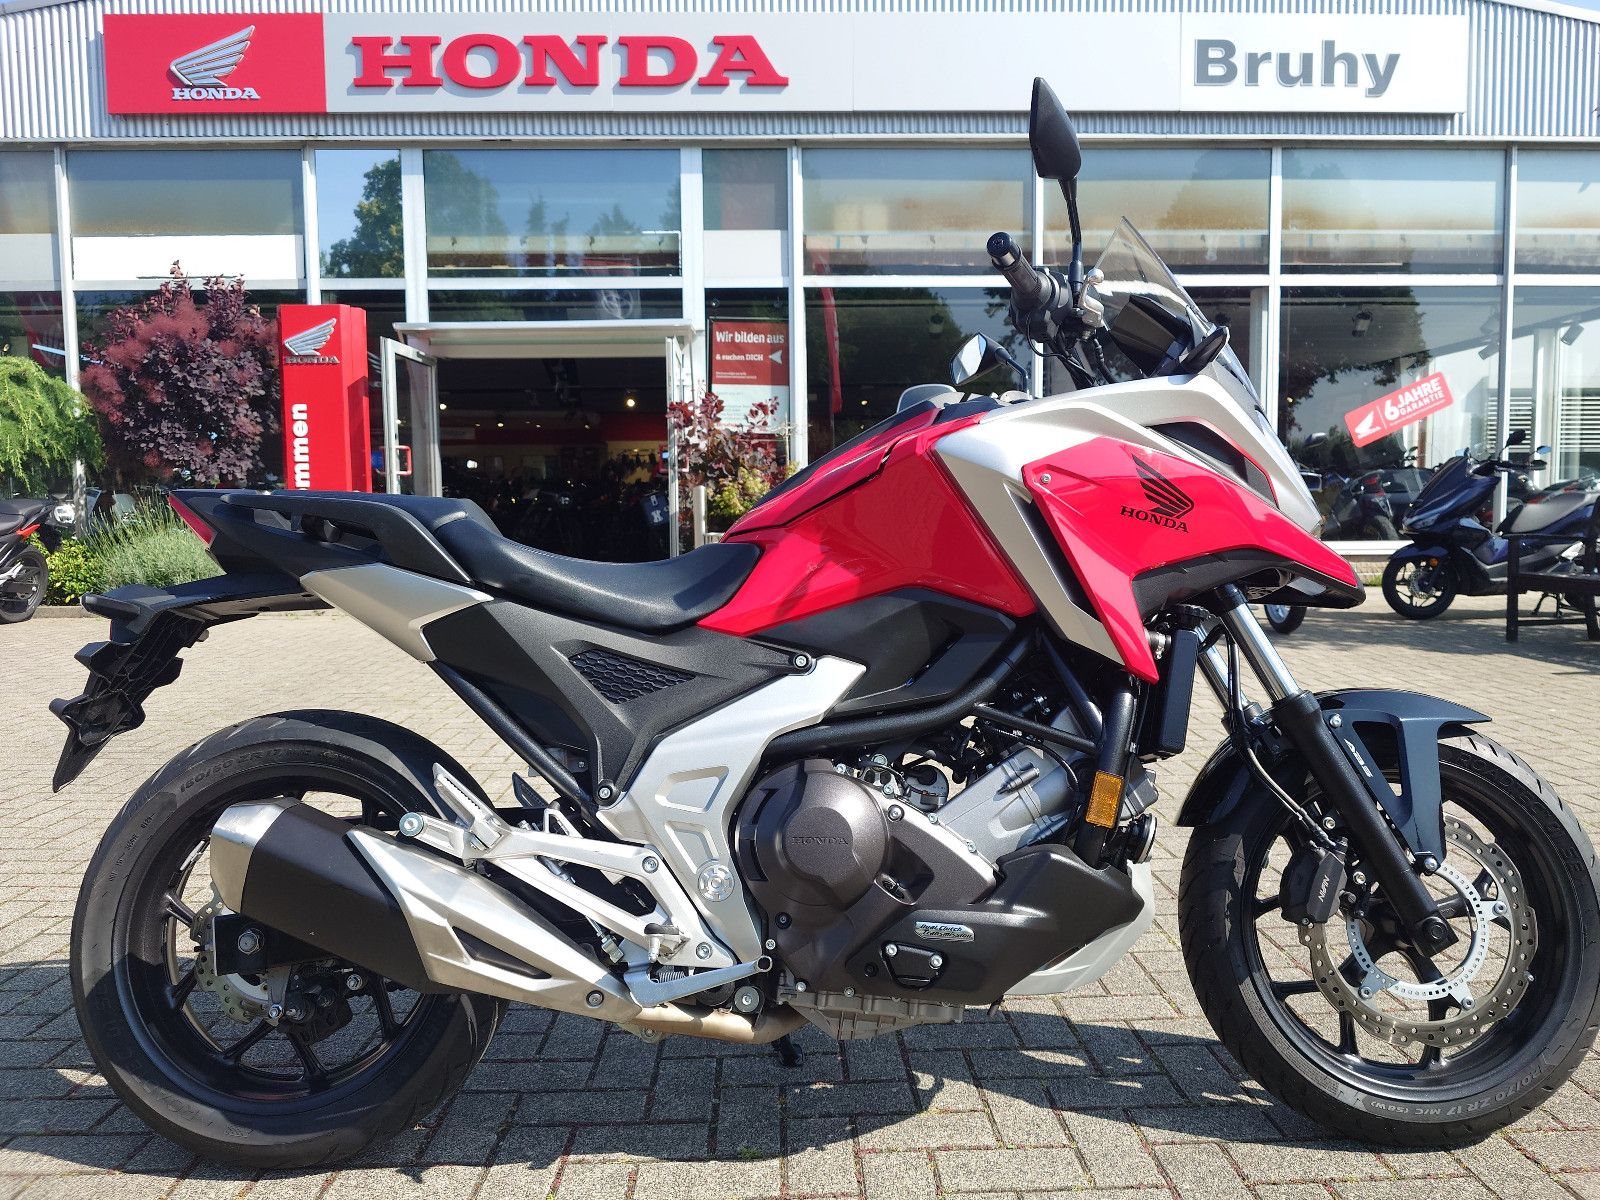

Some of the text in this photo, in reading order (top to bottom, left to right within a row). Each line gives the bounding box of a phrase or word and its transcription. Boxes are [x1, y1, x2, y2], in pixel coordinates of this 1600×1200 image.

[352, 34, 789, 88] HONDA
[1194, 39, 1400, 97] Bruhy
[171, 87, 261, 101] HONDA
[715, 330, 785, 344] Wir bilden aus
[285, 355, 341, 365] HONDA
[715, 353, 721, 361] &
[745, 353, 763, 362] DICH
[1384, 376, 1441, 421] 6 JAHRE
[1400, 390, 1445, 416] GARANTIE
[292, 403, 311, 489] mmen
[1120, 505, 1189, 533] HONDA
[791, 836, 849, 846] HONDA
[920, 923, 939, 931] Dual
[1466, 1096, 1491, 1113] ZR
